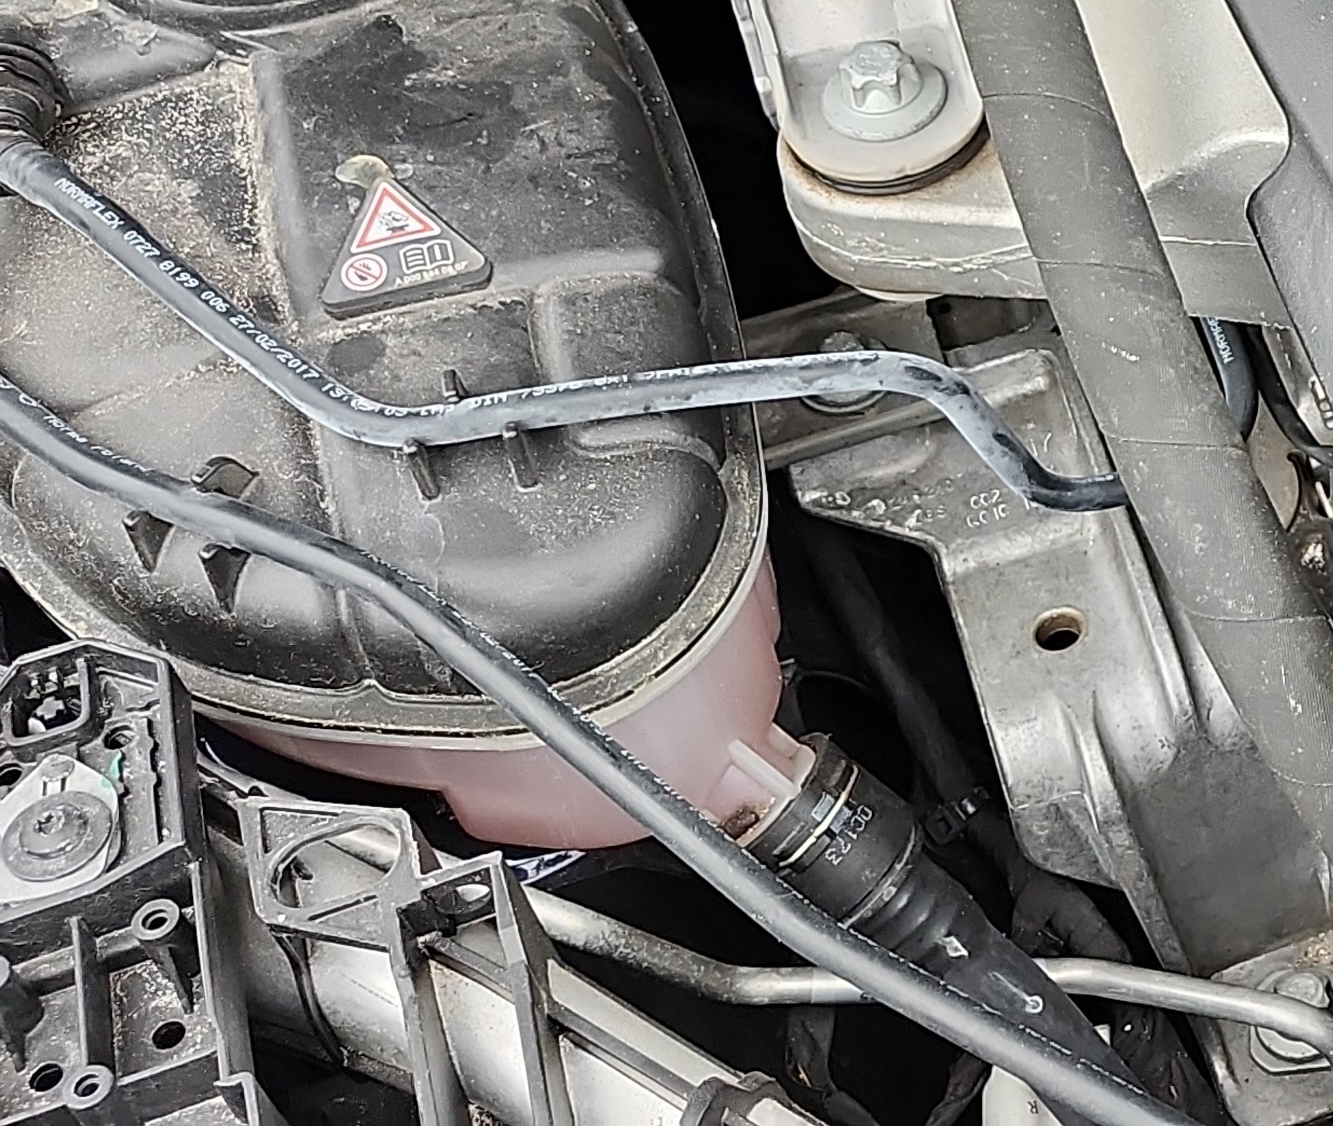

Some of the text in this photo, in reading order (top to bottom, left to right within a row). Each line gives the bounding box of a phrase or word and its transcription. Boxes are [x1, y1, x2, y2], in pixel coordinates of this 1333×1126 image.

[54, 177, 126, 229] NORMAFLEX
[123, 230, 163, 259] 0727
[158, 260, 200, 289] 8199
[200, 290, 231, 314] 006
[229, 314, 321, 382] 27/02/2017
